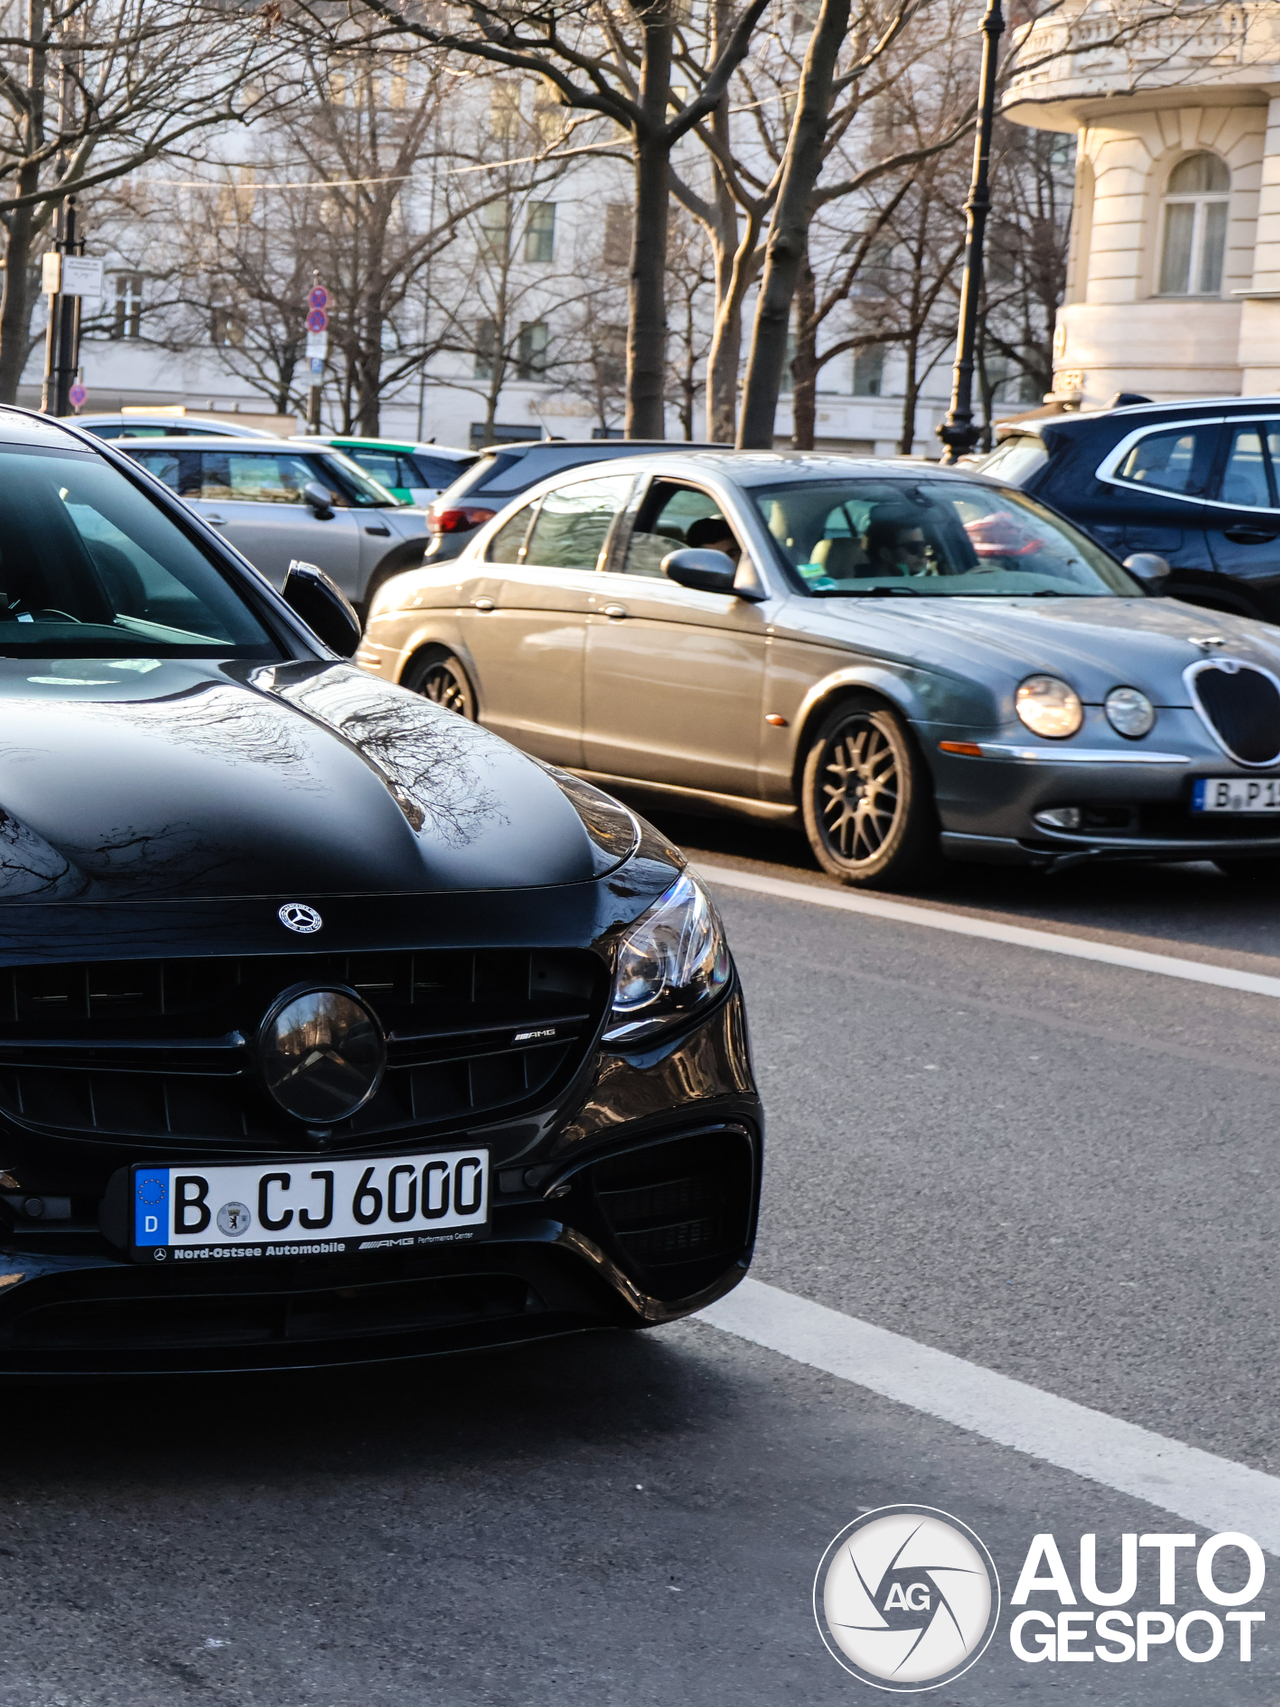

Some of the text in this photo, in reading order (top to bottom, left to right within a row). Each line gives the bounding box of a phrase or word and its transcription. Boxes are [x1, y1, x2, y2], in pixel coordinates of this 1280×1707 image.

[1215, 782, 1231, 807] B
[1264, 782, 1280, 807] 1
[527, 1028, 556, 1039] AMG
[174, 1157, 482, 1234] B CJ 6000
[145, 1216, 158, 1233] D
[174, 1232, 473, 1260] Nord-Ostsee Automobile AMG Performance Center
